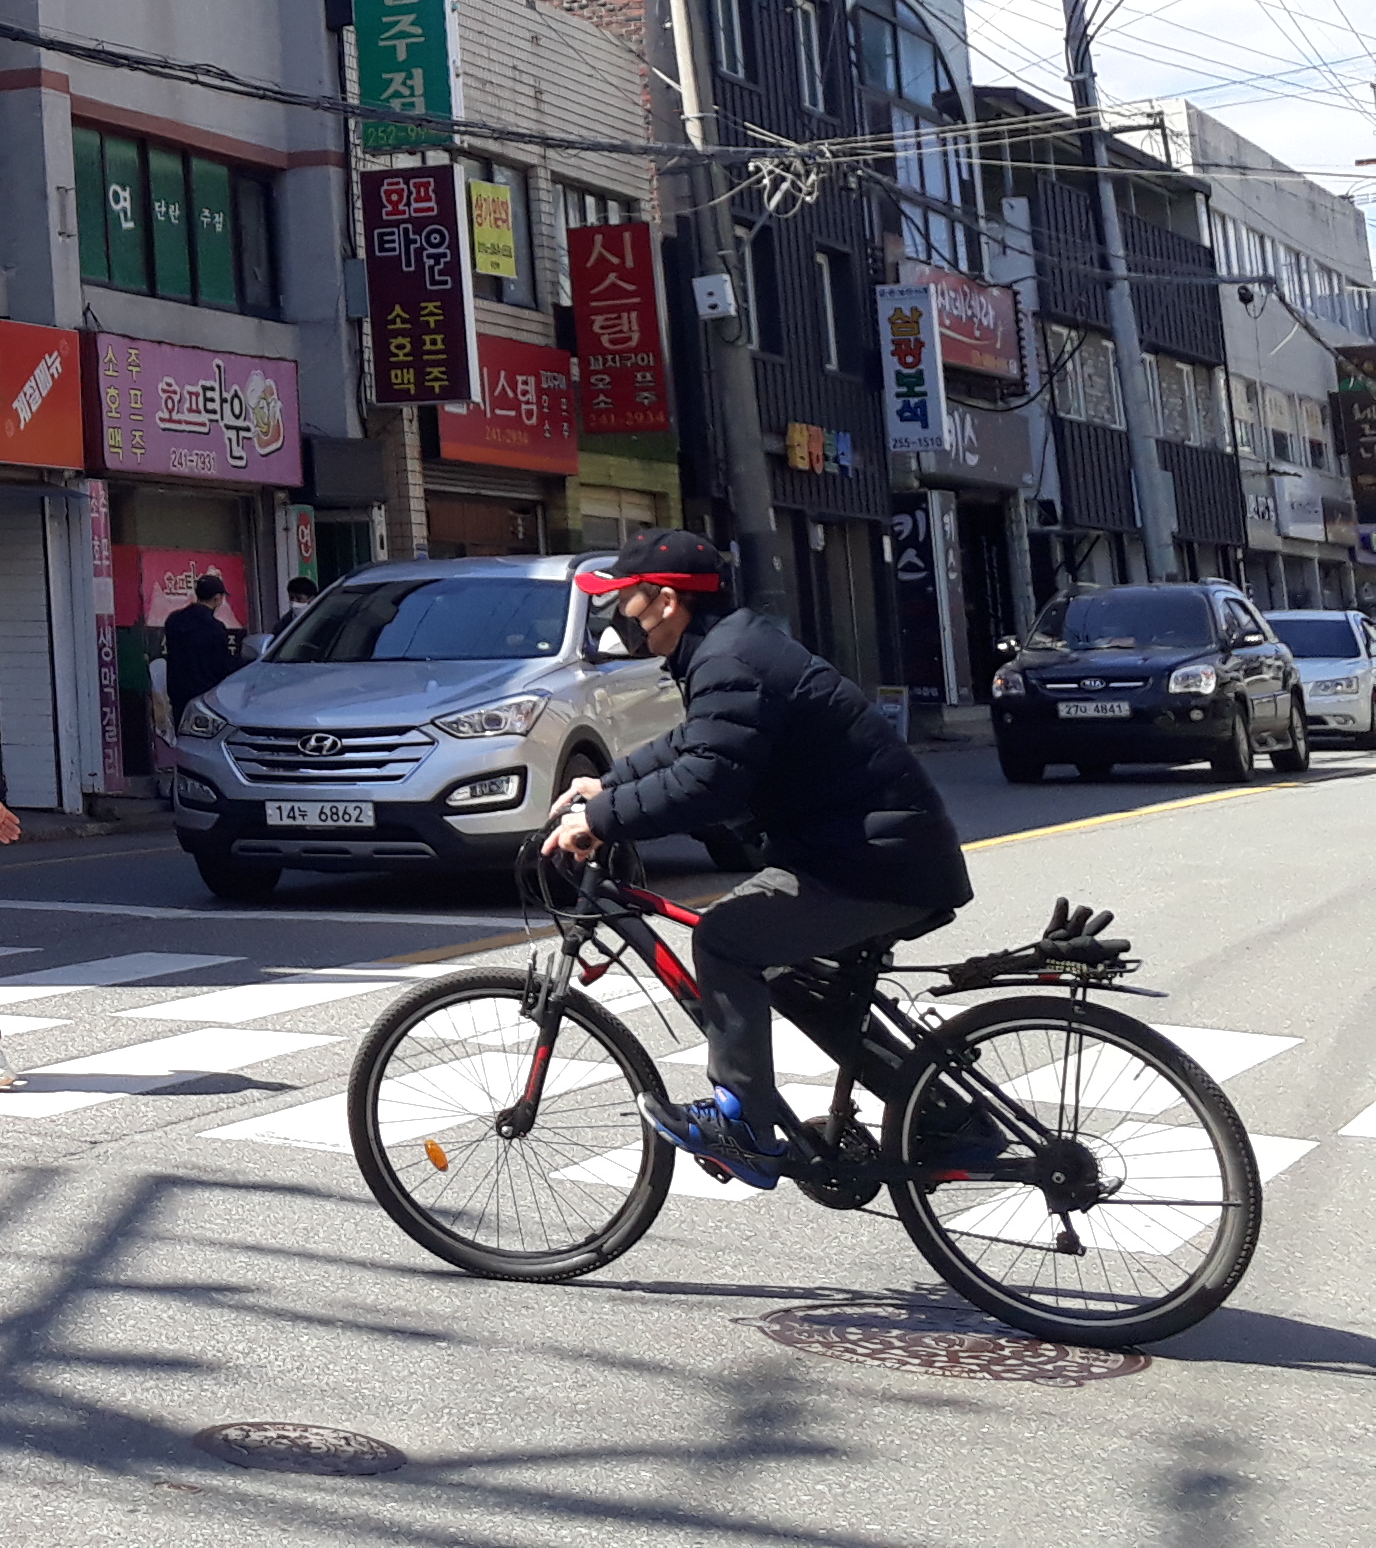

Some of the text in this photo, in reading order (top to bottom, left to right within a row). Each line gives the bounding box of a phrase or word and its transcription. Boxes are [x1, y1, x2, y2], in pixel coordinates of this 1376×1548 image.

[109, 183, 135, 230] 연
[381, 178, 437, 220] 호프
[374, 224, 452, 290] 타운
[586, 231, 641, 349] 시스템
[887, 306, 930, 430] 삼광보석
[171, 448, 216, 473] 241-7931
[891, 436, 943, 450] 255-1510
[892, 508, 929, 582] 키스
[318, 804, 364, 823] 6862
